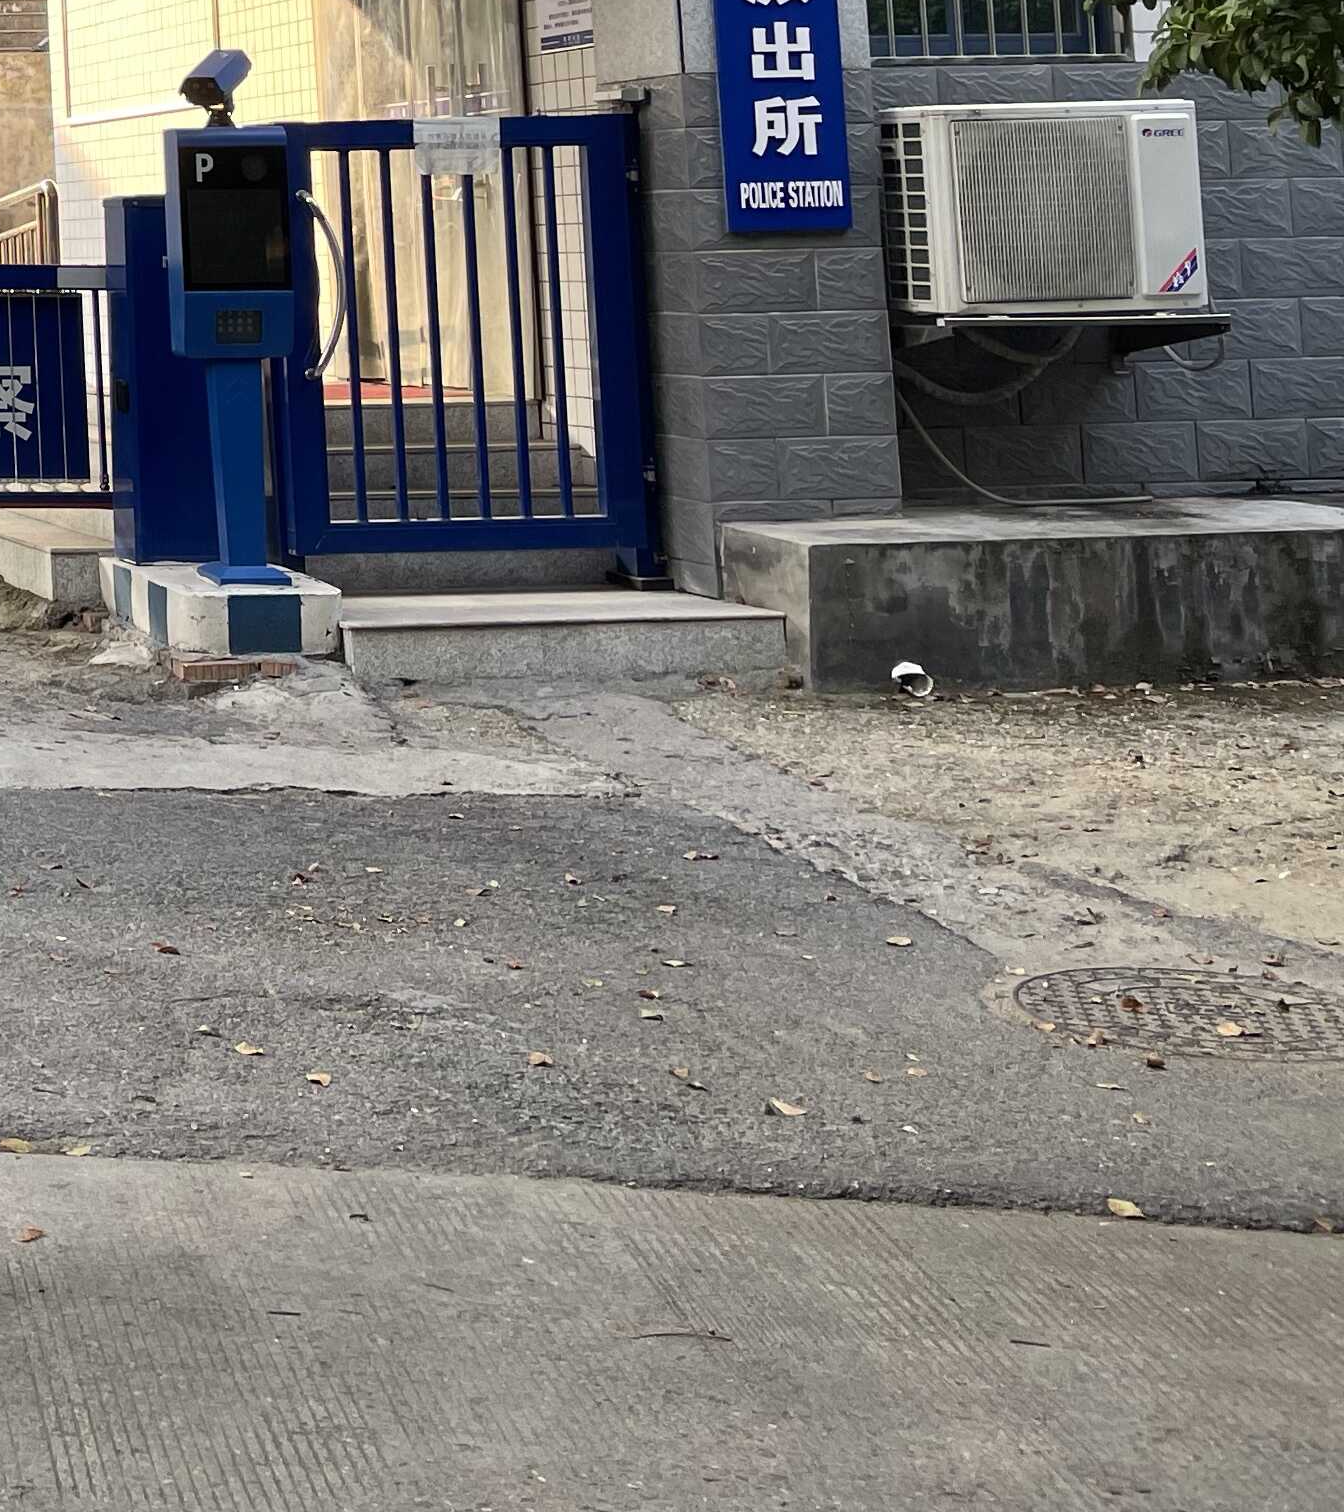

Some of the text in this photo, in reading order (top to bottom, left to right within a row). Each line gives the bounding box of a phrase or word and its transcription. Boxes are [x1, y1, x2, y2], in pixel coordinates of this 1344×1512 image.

[195, 153, 214, 182] P
[739, 180, 844, 209] POLICE STATION
